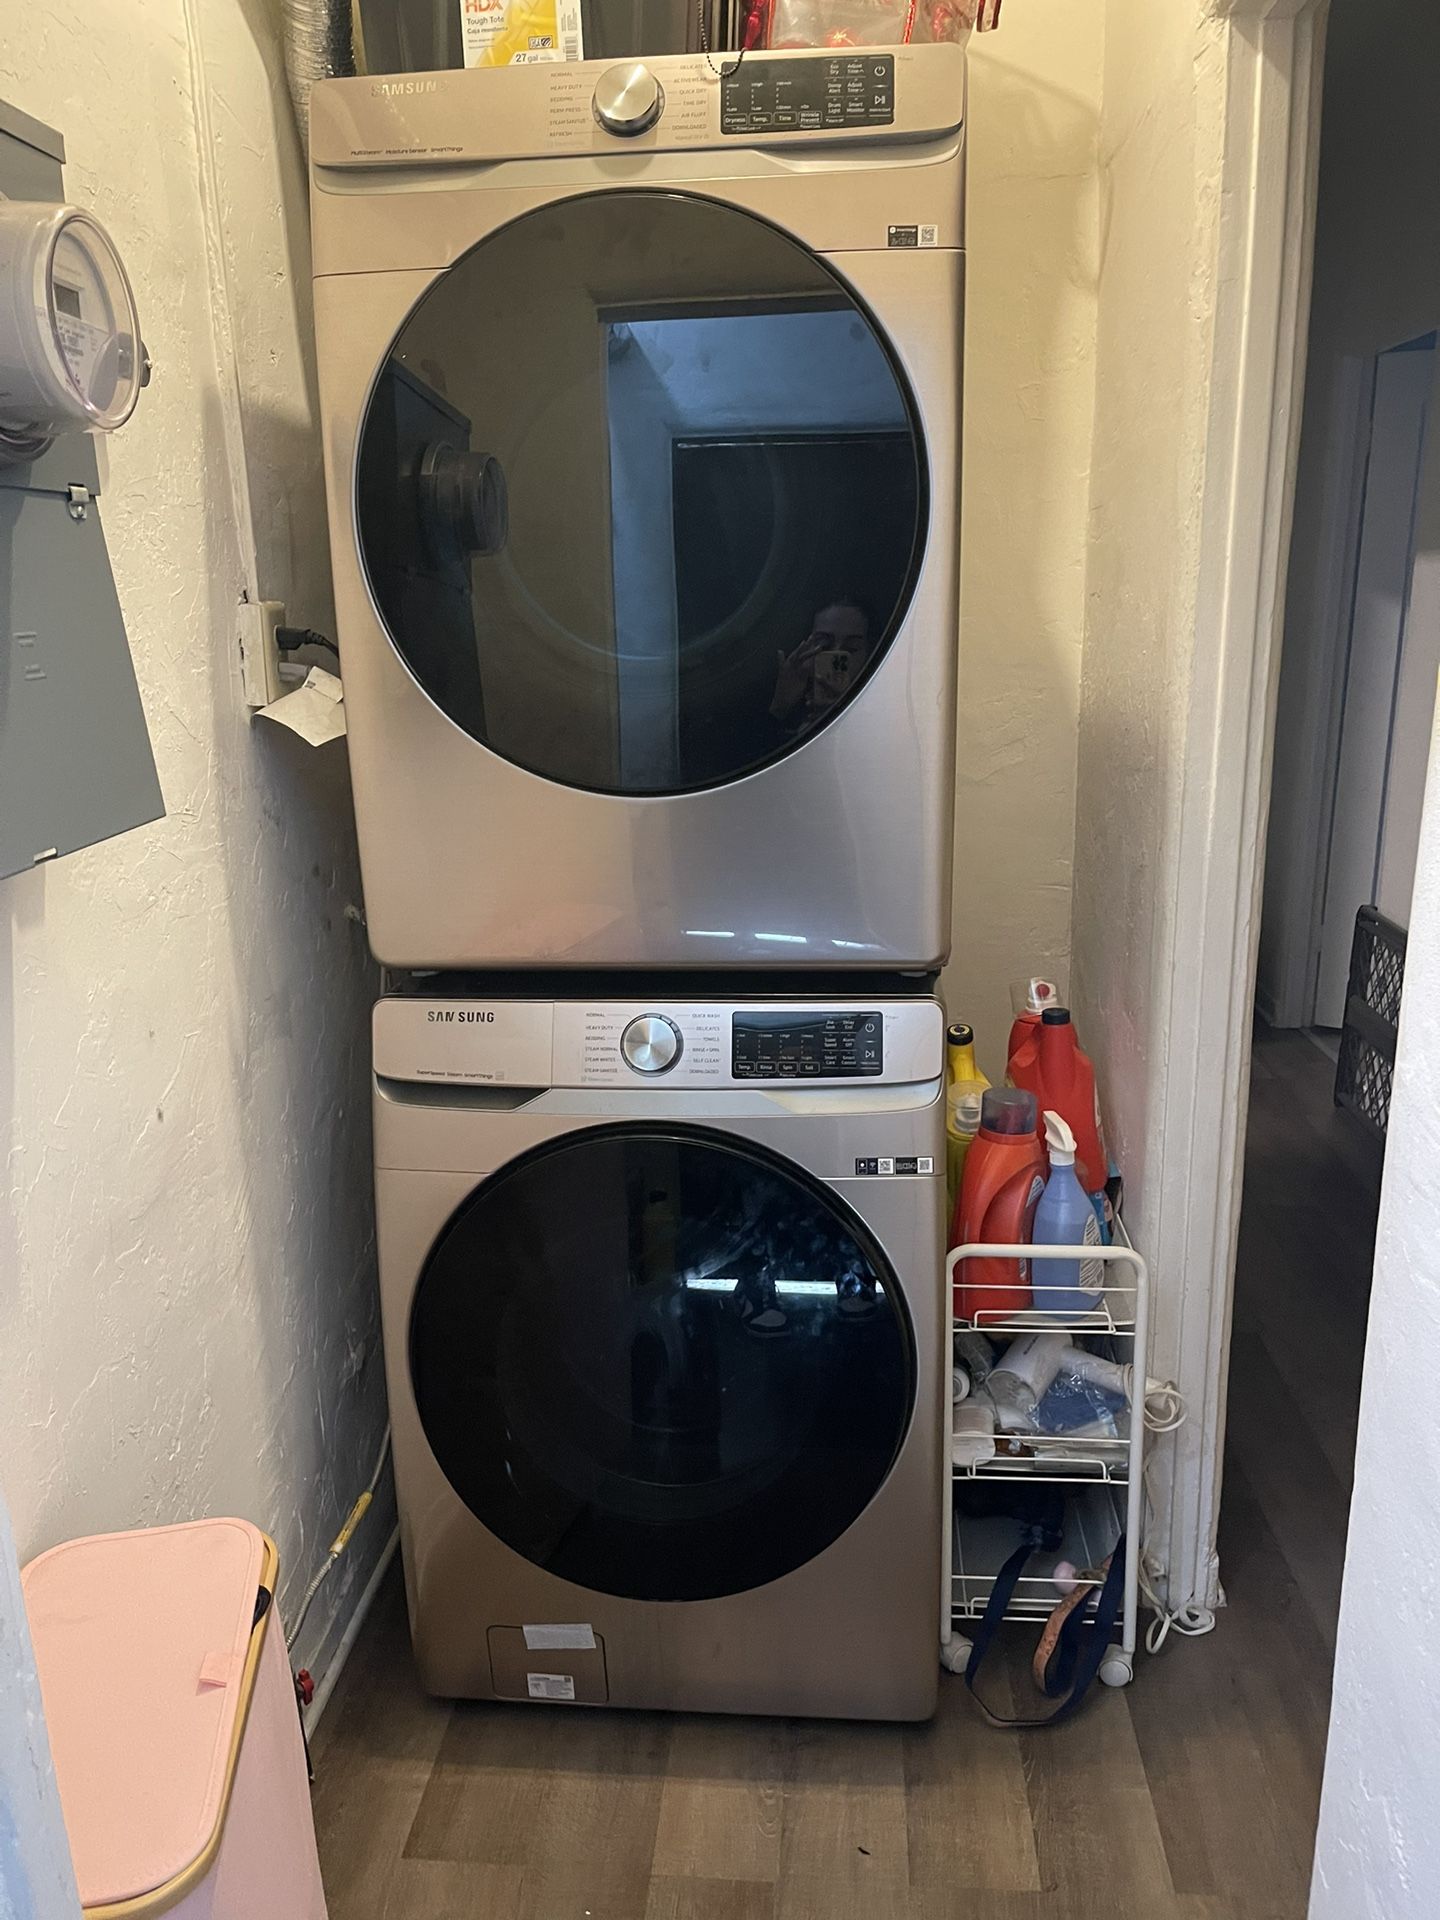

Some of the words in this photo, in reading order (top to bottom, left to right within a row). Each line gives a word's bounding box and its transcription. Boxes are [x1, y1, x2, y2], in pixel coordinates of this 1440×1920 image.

[465, 0, 503, 13] HDX
[467, 17, 488, 26] Tough
[516, 53, 526, 63] 27
[528, 54, 538, 63] gal
